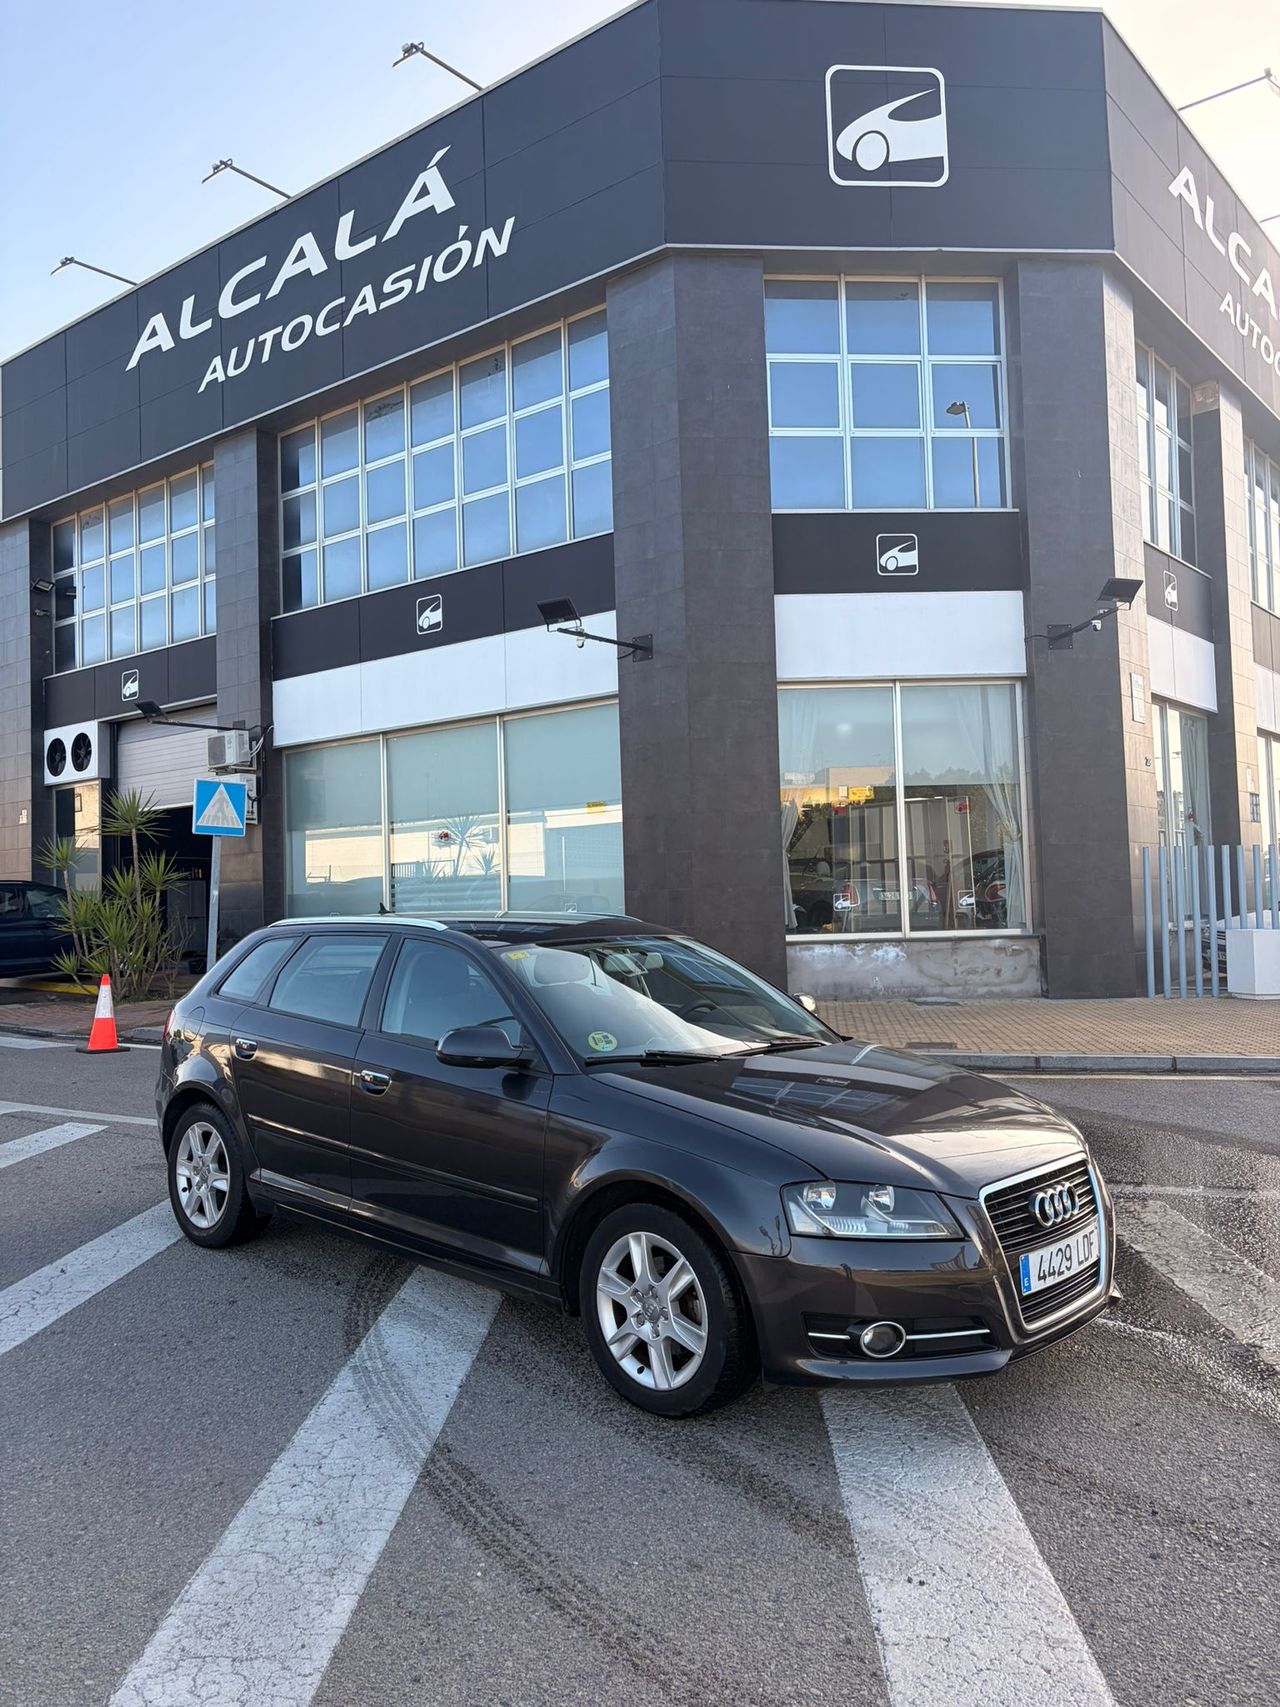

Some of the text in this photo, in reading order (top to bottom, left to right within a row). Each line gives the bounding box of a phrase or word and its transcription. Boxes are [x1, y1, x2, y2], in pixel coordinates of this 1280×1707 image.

[125, 145, 456, 371] ALCALÁ
[198, 216, 515, 394] AUTOCASIÓN
[1168, 165, 1280, 322] ALCA
[1037, 1229, 1095, 1283] 4429 LDF
